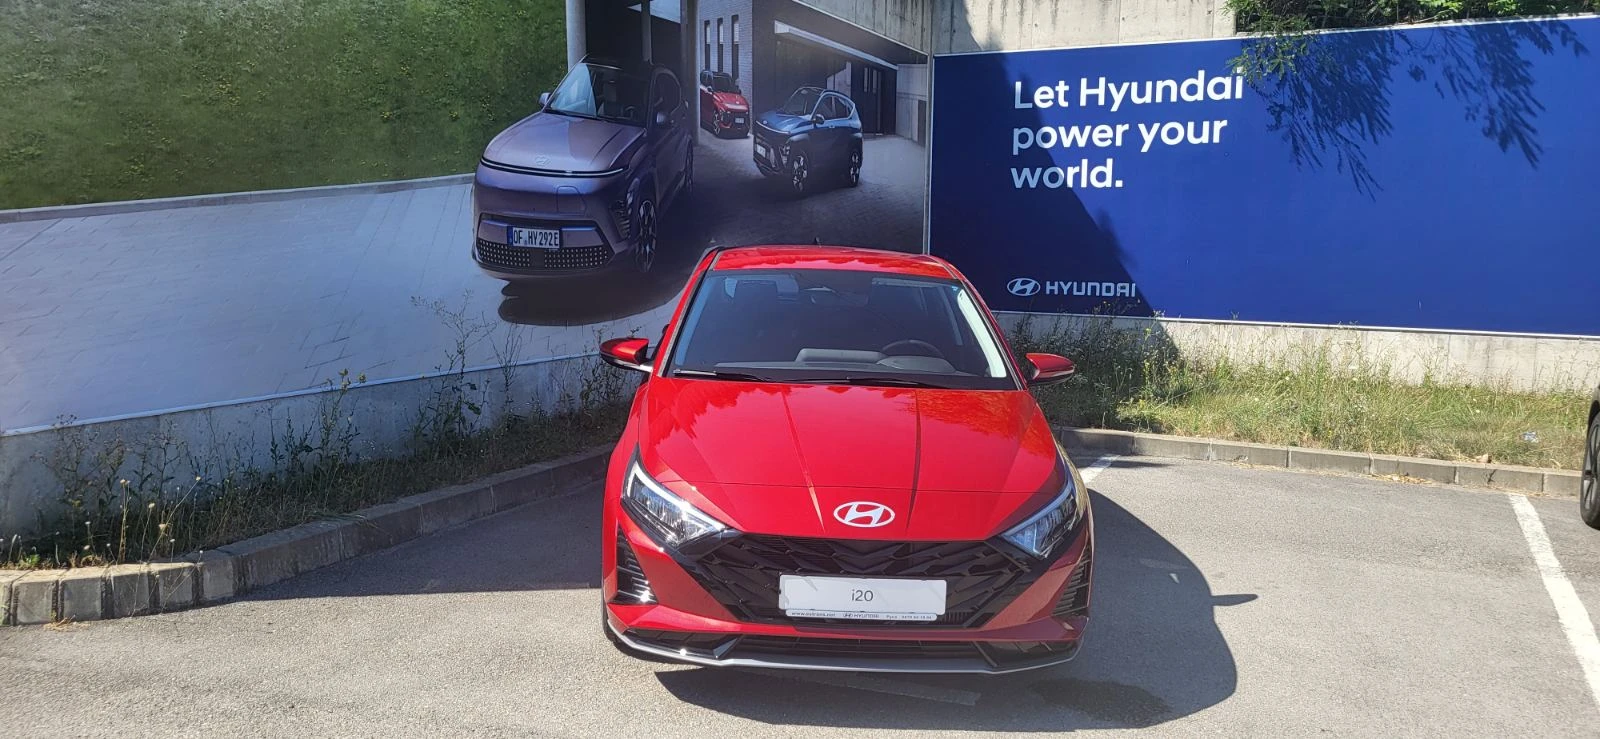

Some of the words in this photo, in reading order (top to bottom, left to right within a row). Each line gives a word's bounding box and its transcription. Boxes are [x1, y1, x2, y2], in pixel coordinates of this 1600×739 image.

[1014, 80, 1069, 109] Let
[1079, 66, 1244, 112] Hyundai
[1012, 122, 1129, 155] power
[1137, 119, 1227, 152] your
[1010, 158, 1123, 189] world.
[514, 229, 523, 244] OF
[1045, 280, 1136, 298] HYUNDAI
[851, 588, 874, 602] i20
